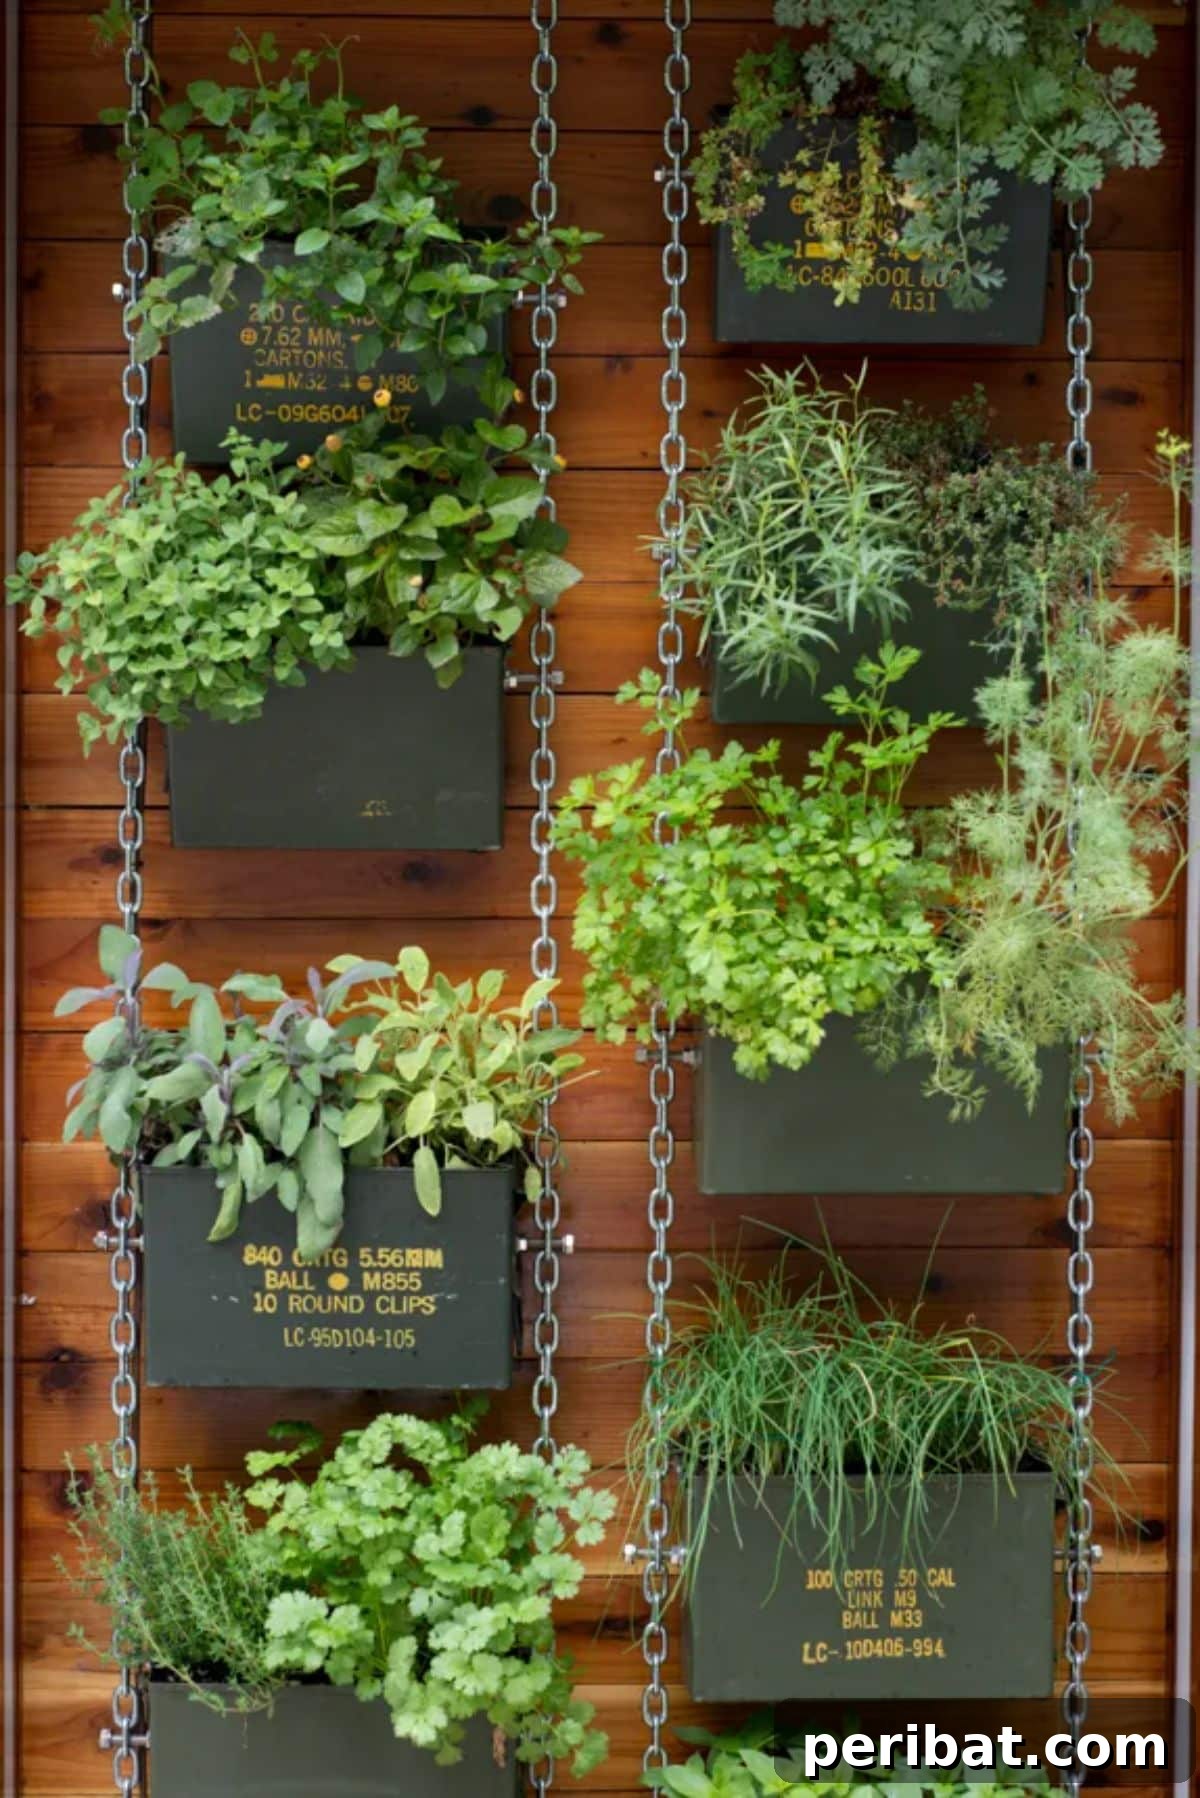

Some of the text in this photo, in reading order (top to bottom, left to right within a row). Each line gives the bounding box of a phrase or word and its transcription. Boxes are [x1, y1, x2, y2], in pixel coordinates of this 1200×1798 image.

[888, 290, 938, 312] A131
[248, 303, 286, 323] 20
[261, 325, 302, 346] 7.62
[242, 1243, 283, 1268] 840
[264, 1269, 423, 1292] BALL M855
[252, 1291, 438, 1316] 10 ROUND CLIPS
[805, 1568, 833, 1590] 100
[843, 1569, 884, 1589] CRTG
[926, 1567, 957, 1588] CAL
[847, 1588, 917, 1609] LINK M9
[841, 1608, 923, 1630] BALL M33
